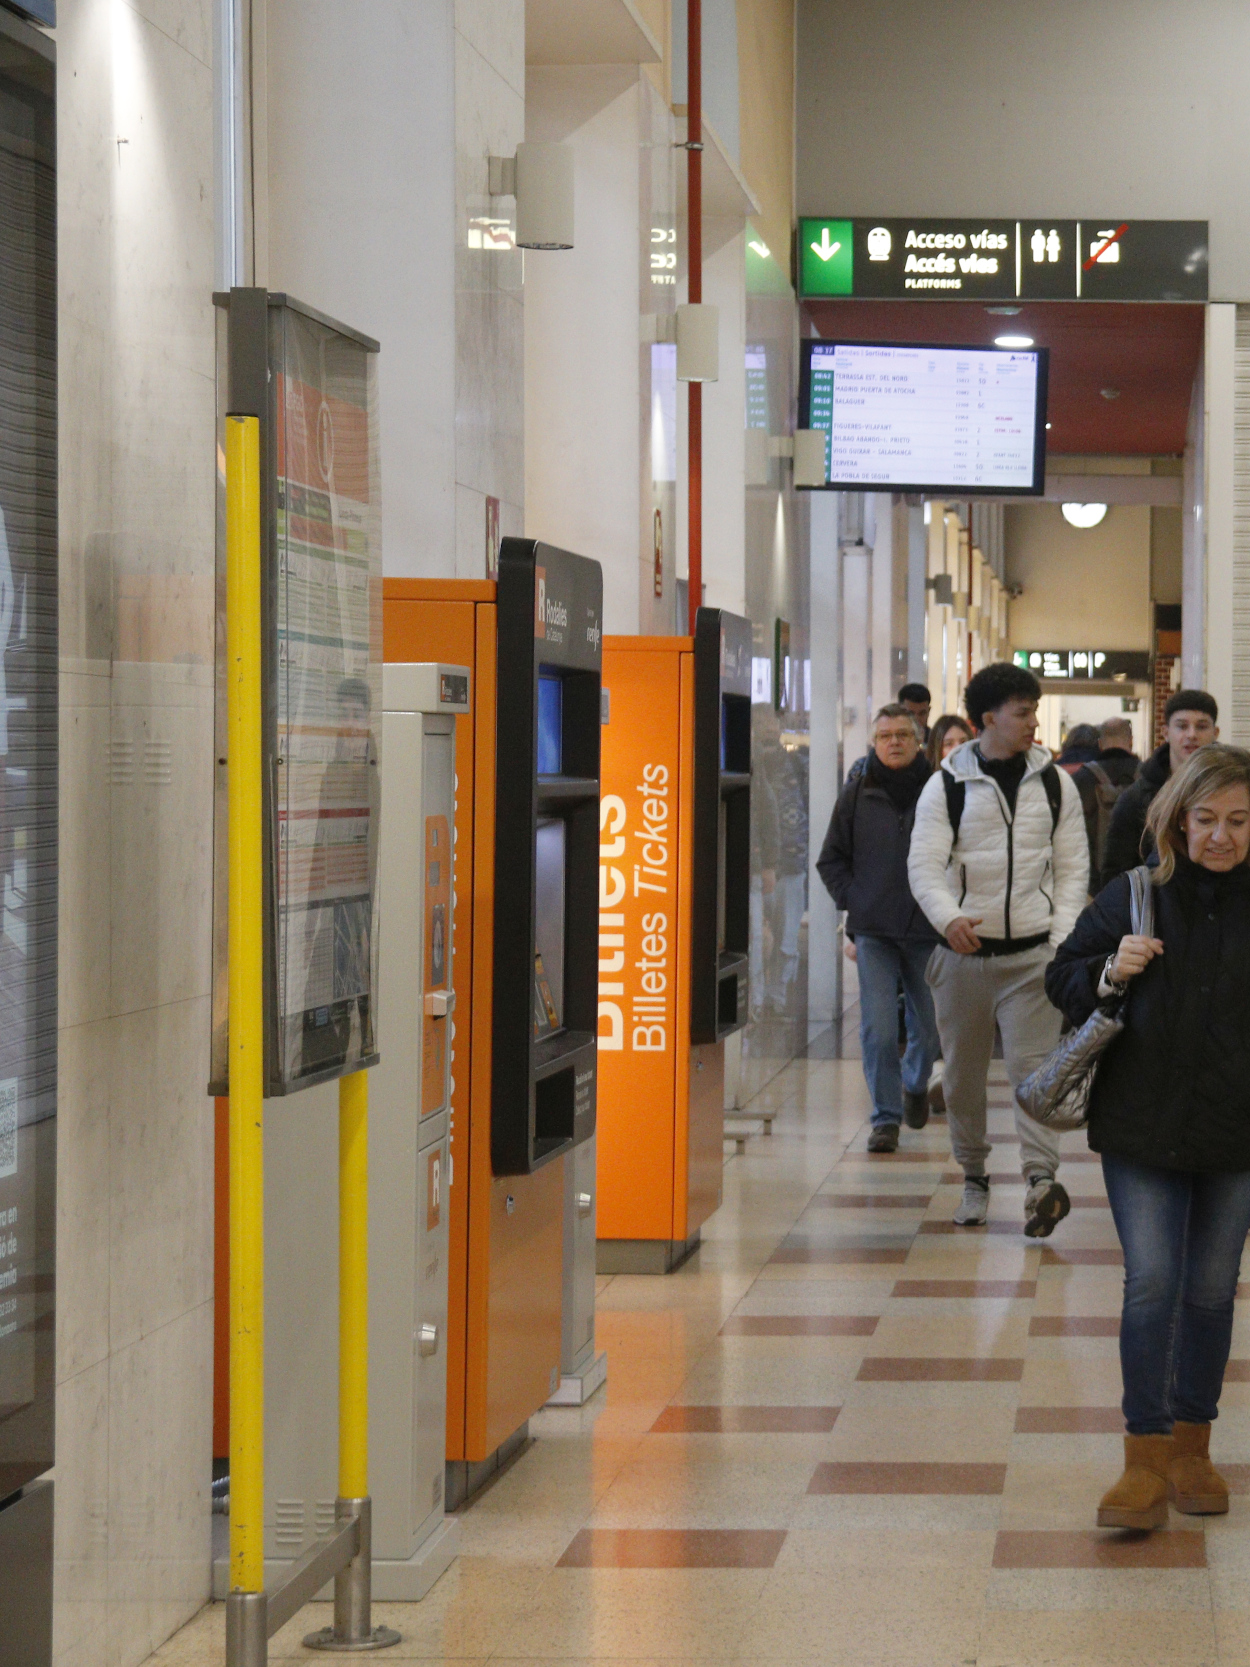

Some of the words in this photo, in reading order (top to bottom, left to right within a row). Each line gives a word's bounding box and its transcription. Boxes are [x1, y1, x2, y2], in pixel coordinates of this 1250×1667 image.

[904, 230, 966, 249] Acceso
[970, 229, 1008, 249] vías
[904, 253, 956, 273] Accés
[959, 253, 999, 274] vies
[904, 278, 962, 289] PLATFORMS
[865, 349, 891, 357] Sortidas
[539, 578, 546, 622] R
[546, 599, 568, 628] Rodalies
[586, 620, 600, 652] renfe
[633, 763, 669, 897] Tickets
[632, 912, 668, 1051] Billetes
[433, 1159, 440, 1207] R
[8, 1231, 17, 1255] de
